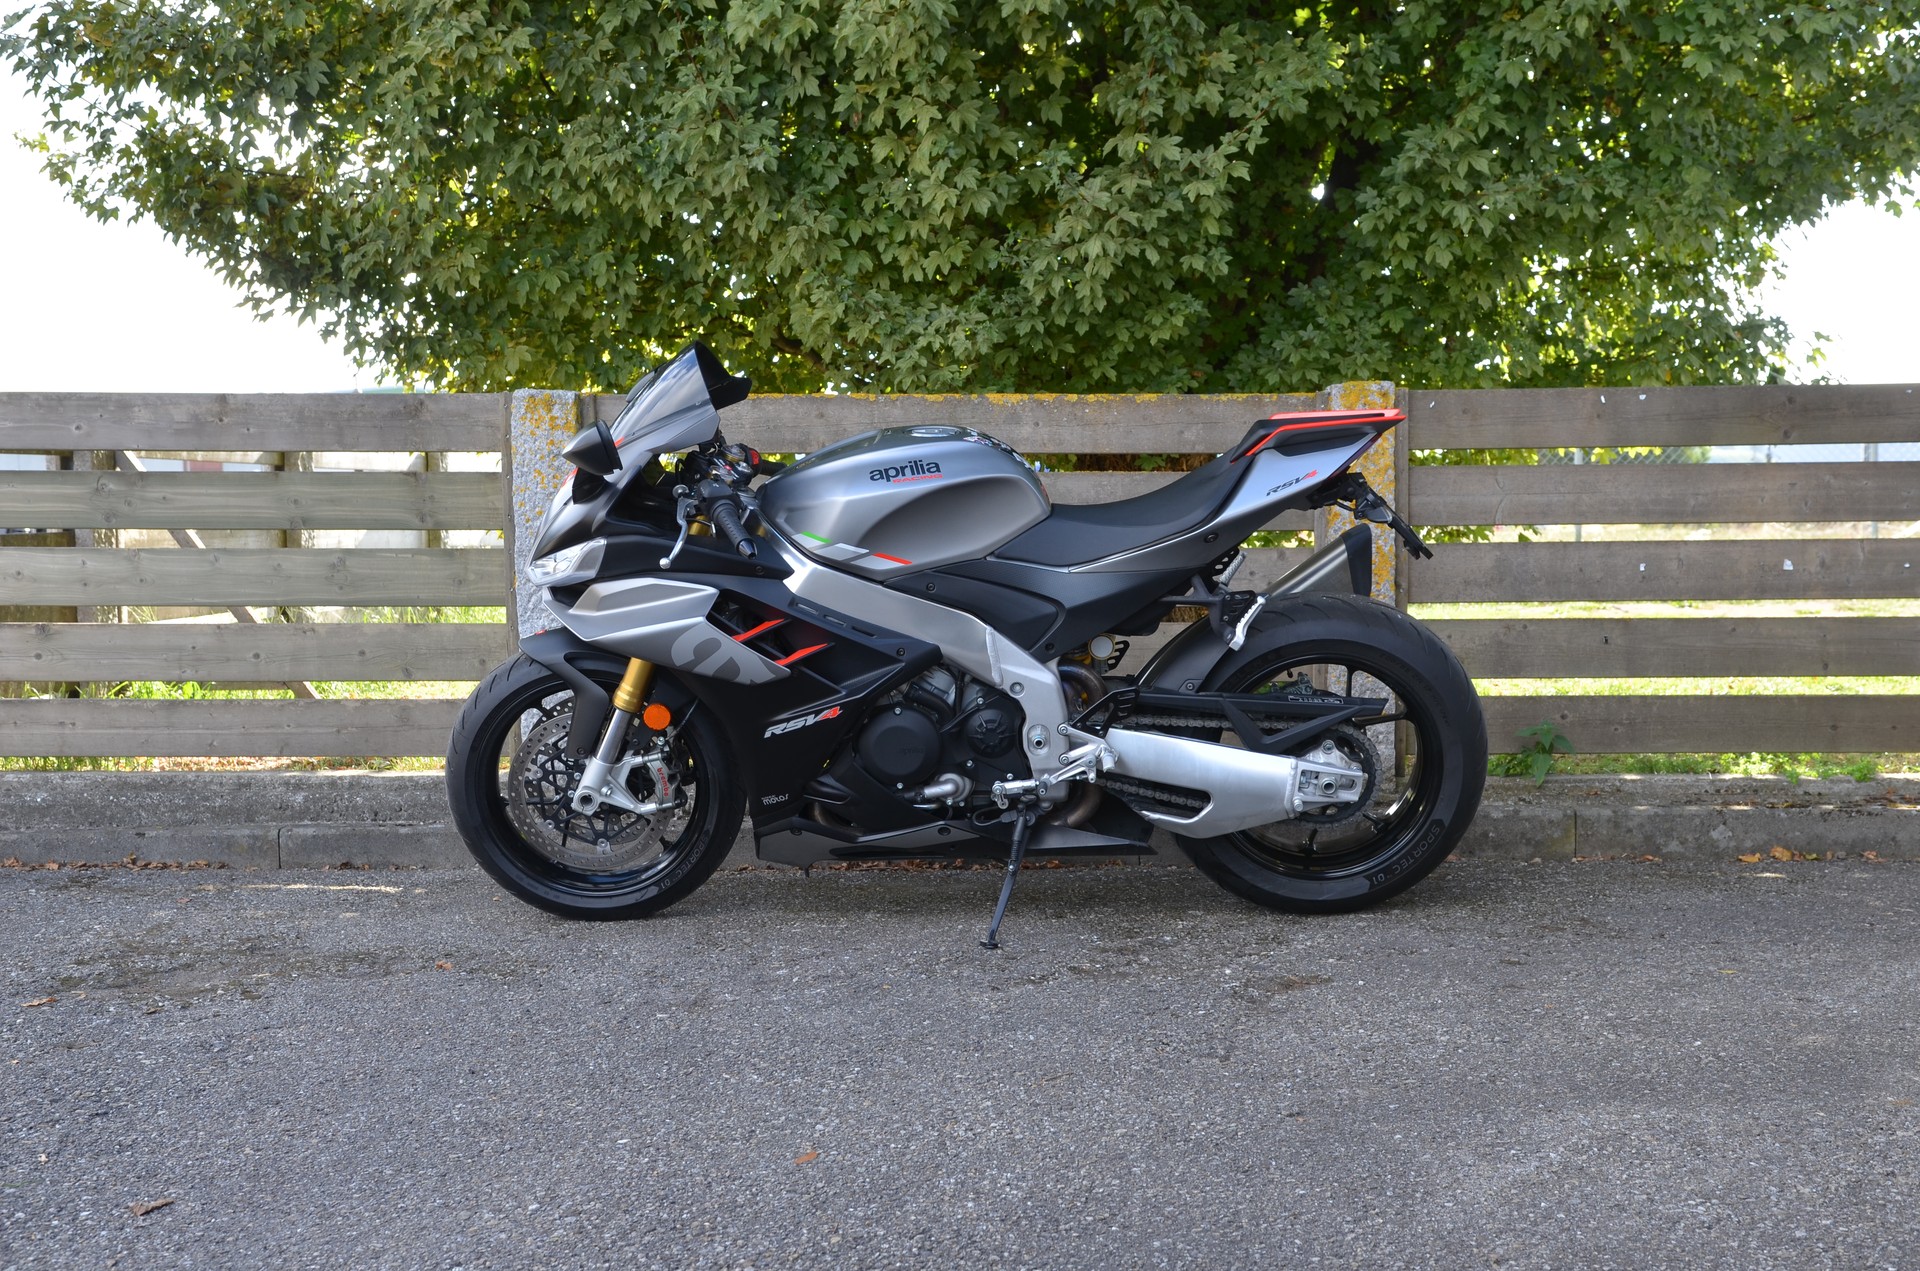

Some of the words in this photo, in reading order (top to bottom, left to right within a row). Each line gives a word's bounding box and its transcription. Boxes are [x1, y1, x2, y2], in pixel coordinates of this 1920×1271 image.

[869, 460, 942, 482] aprilia
[892, 474, 943, 483] RACING
[1266, 469, 1318, 497] RSV4
[764, 705, 843, 738] RSV4
[657, 767, 669, 797] brembo
[676, 836, 708, 877] SPORTEC
[1393, 825, 1440, 874] SPORTEC
